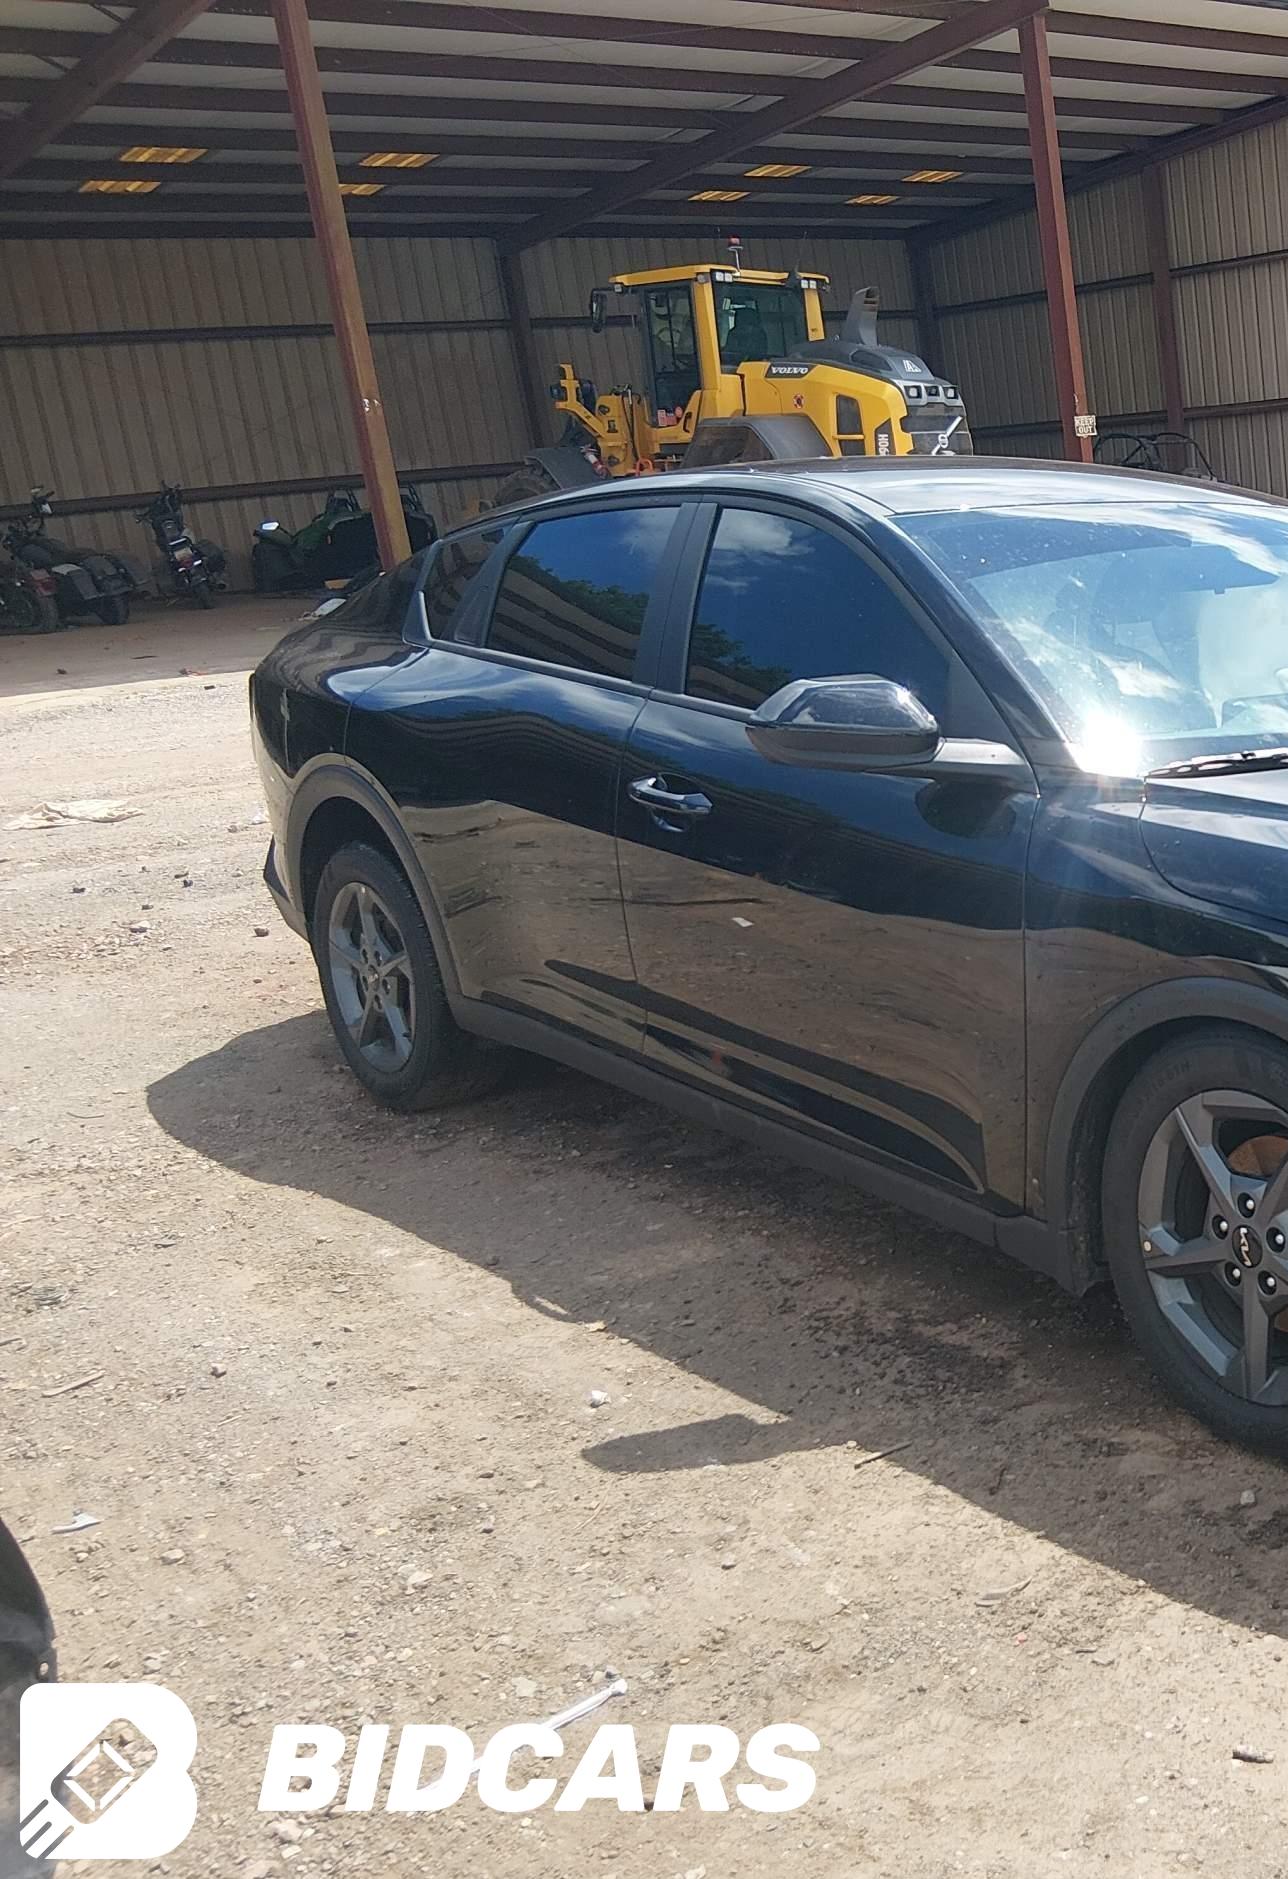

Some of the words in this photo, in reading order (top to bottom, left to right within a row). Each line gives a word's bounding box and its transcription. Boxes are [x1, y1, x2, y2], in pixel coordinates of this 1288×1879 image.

[771, 366, 809, 375] VOLVO
[1075, 416, 1094, 425] KEEP
[1078, 425, 1092, 434] OUT
